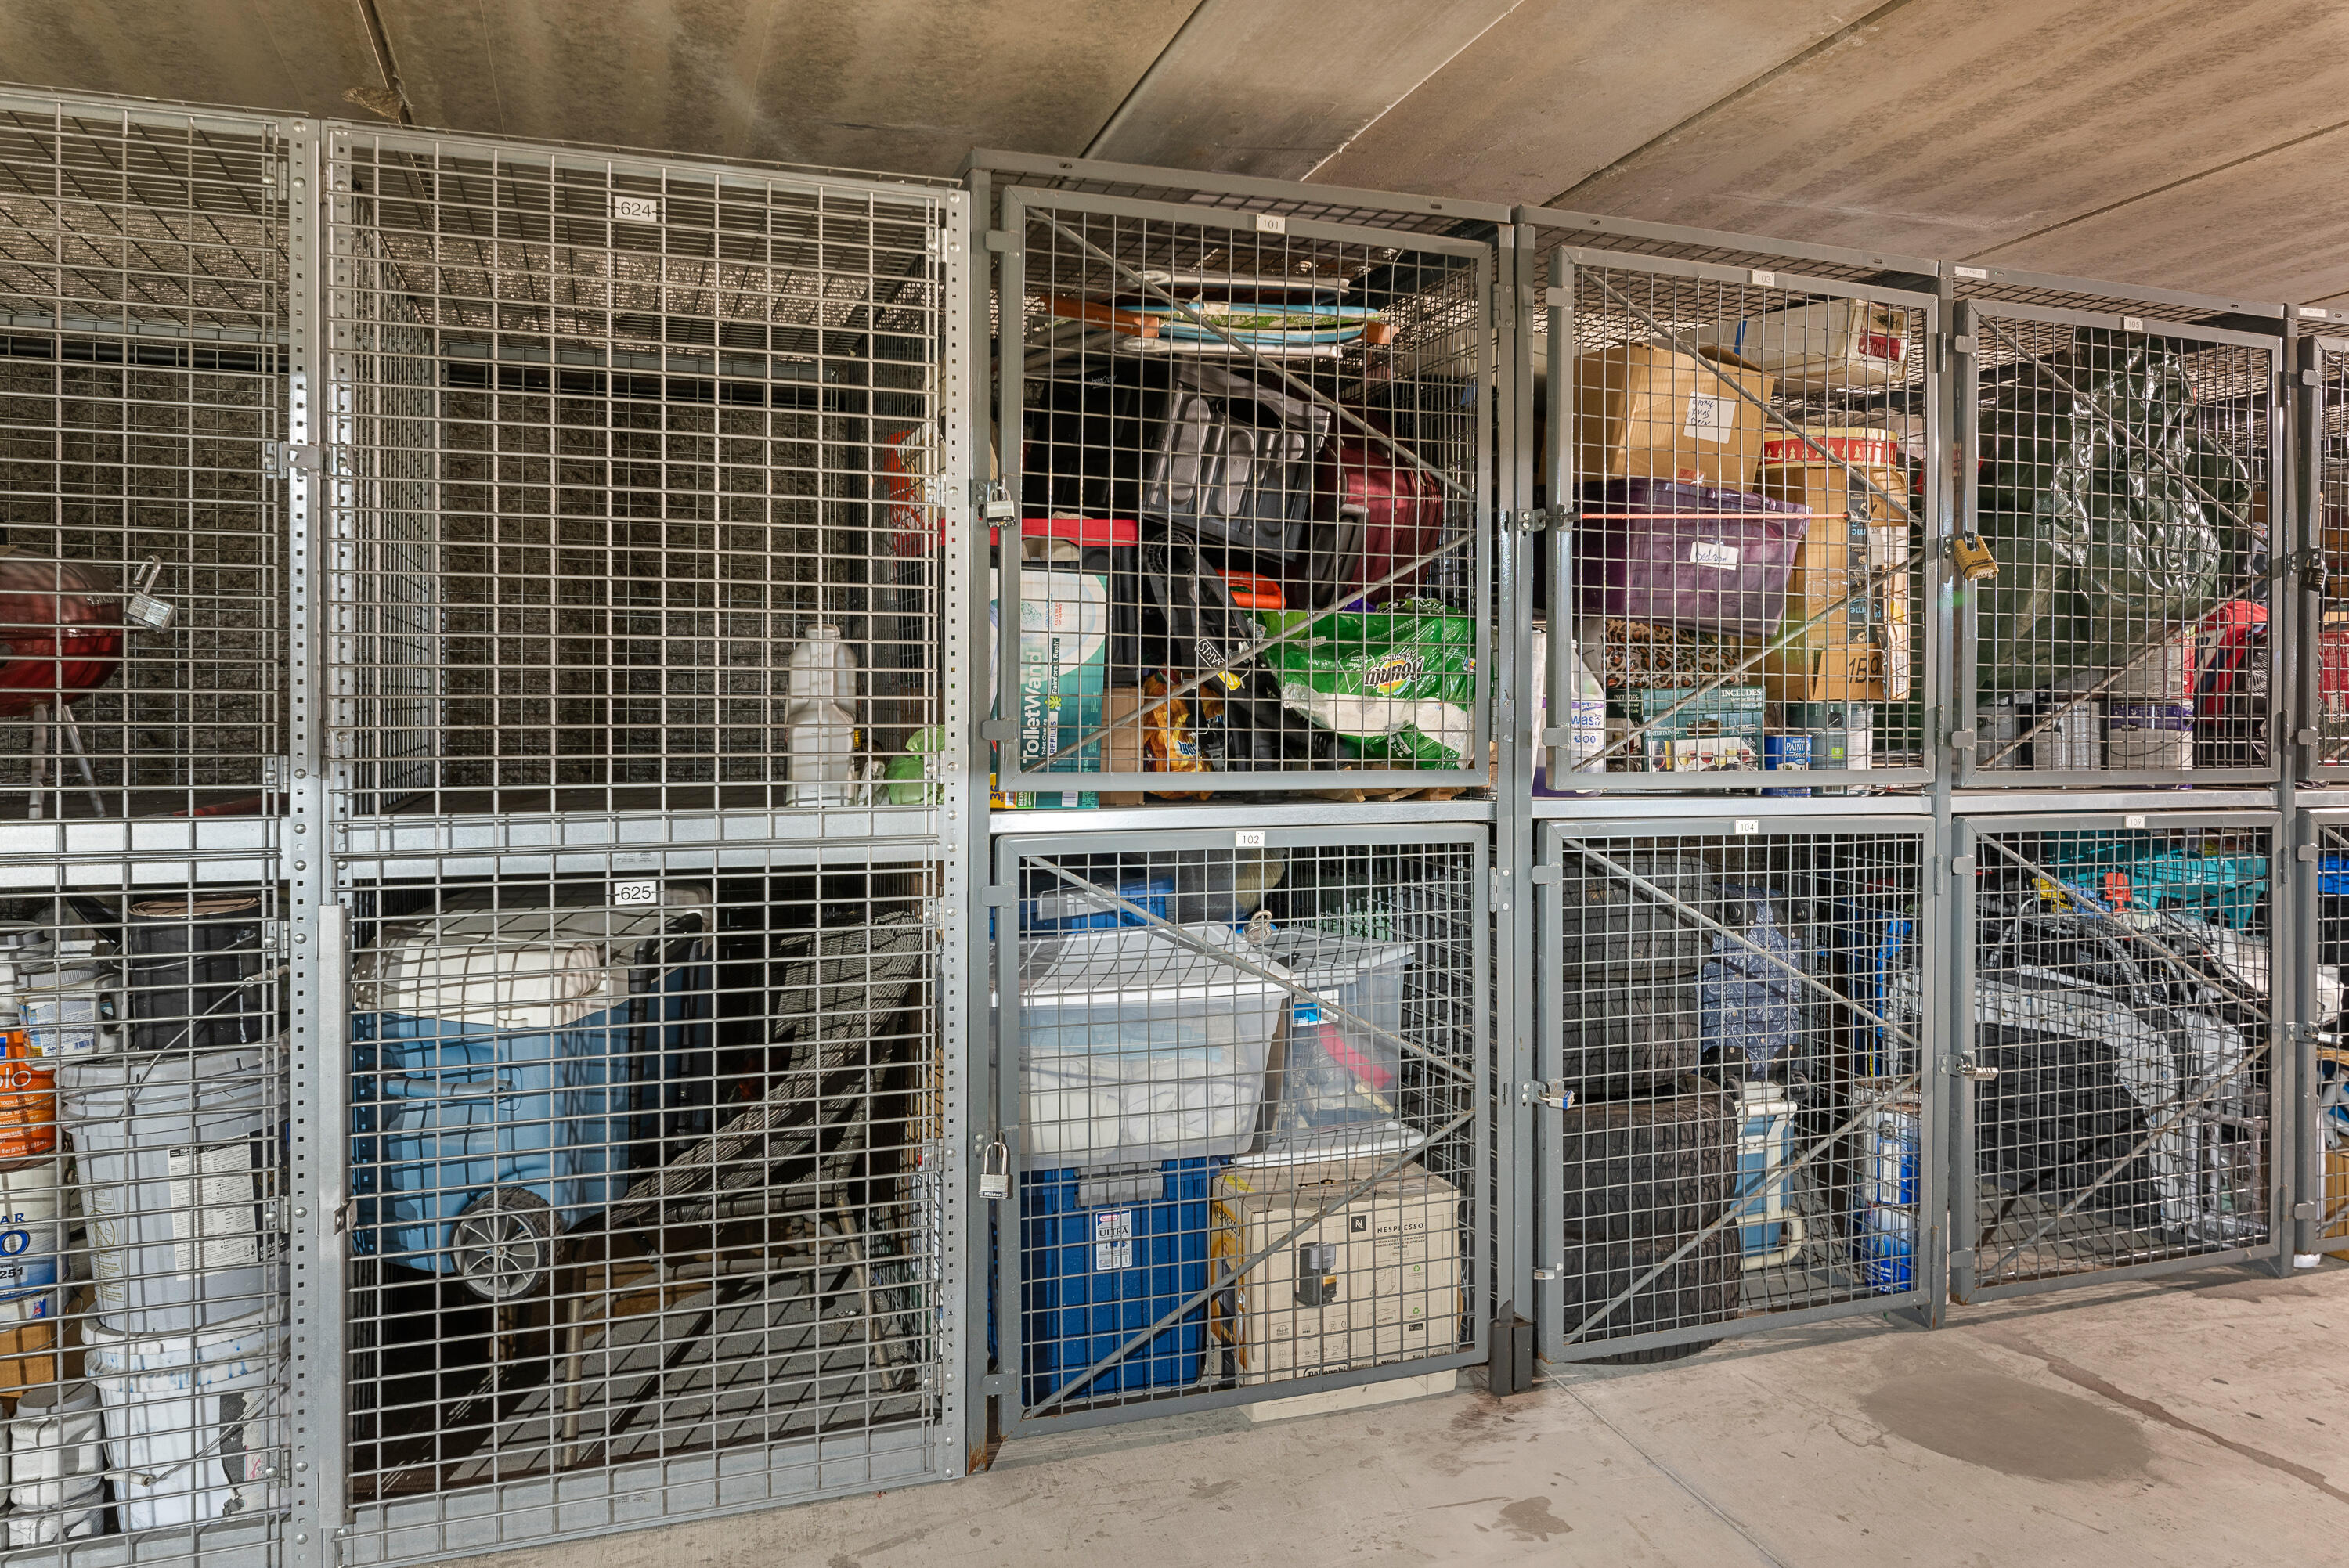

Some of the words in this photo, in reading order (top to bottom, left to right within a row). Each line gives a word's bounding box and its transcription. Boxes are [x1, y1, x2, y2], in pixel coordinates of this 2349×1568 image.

[621, 201, 651, 218] 624
[1264, 218, 1279, 230] 101
[1758, 274, 1771, 284] 103
[2129, 320, 2141, 329] 105
[1199, 641, 1225, 668] SARIS
[1052, 658, 1060, 694] Rainforet
[1365, 657, 1424, 687] Bounty
[1023, 651, 1042, 764] ToiletWand
[2130, 818, 2142, 827] 109
[1243, 835, 1260, 845] 102
[621, 885, 651, 900] 625
[1099, 1227, 1128, 1237] ULTRA
[1377, 1223, 1424, 1234] NESPESSO
